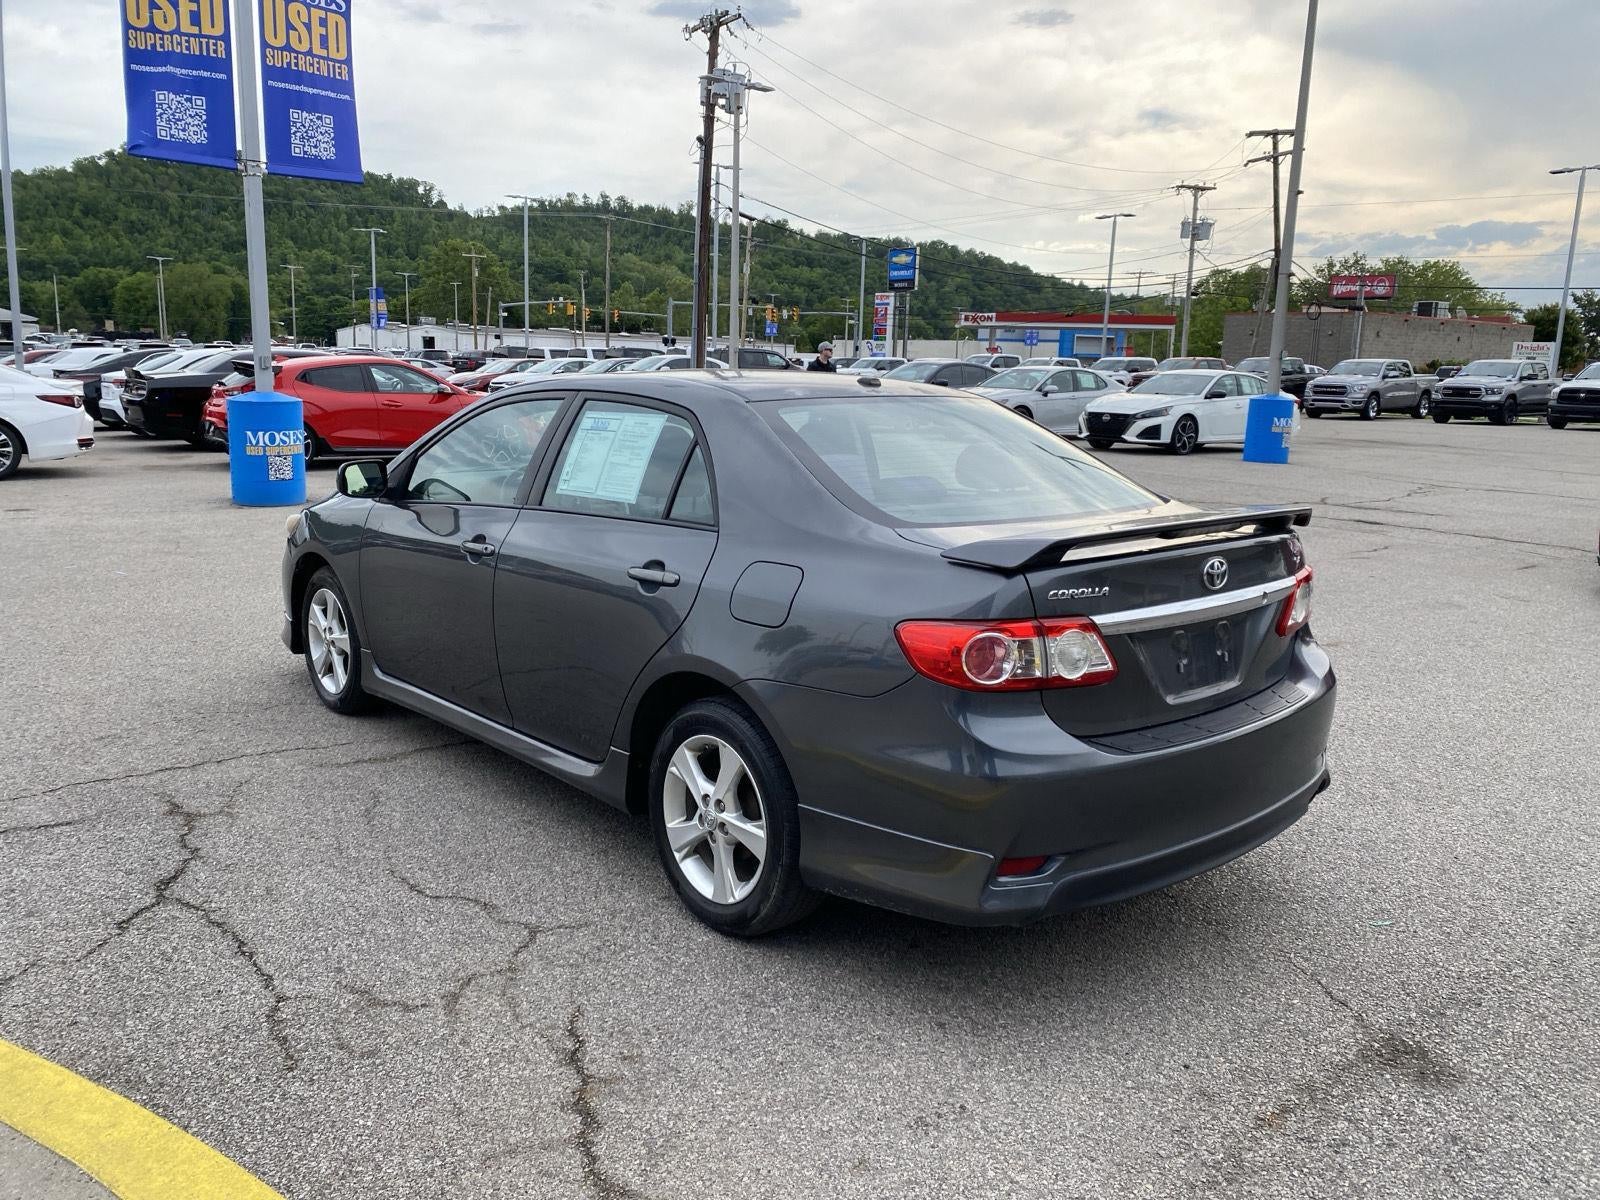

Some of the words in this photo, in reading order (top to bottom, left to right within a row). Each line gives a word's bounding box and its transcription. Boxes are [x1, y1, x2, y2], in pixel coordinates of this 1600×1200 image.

[126, 0, 224, 36] USED
[264, 0, 348, 60] USED
[128, 30, 226, 58] SUPERCENTER
[130, 63, 227, 79] mosesusedsupercenter.com
[265, 48, 348, 80] SUPERCENTER
[267, 80, 351, 100] mosesusedsupercenter.com
[964, 313, 993, 324] EXXON
[246, 446, 264, 455] USED
[1048, 586, 1109, 599] COROLLA
